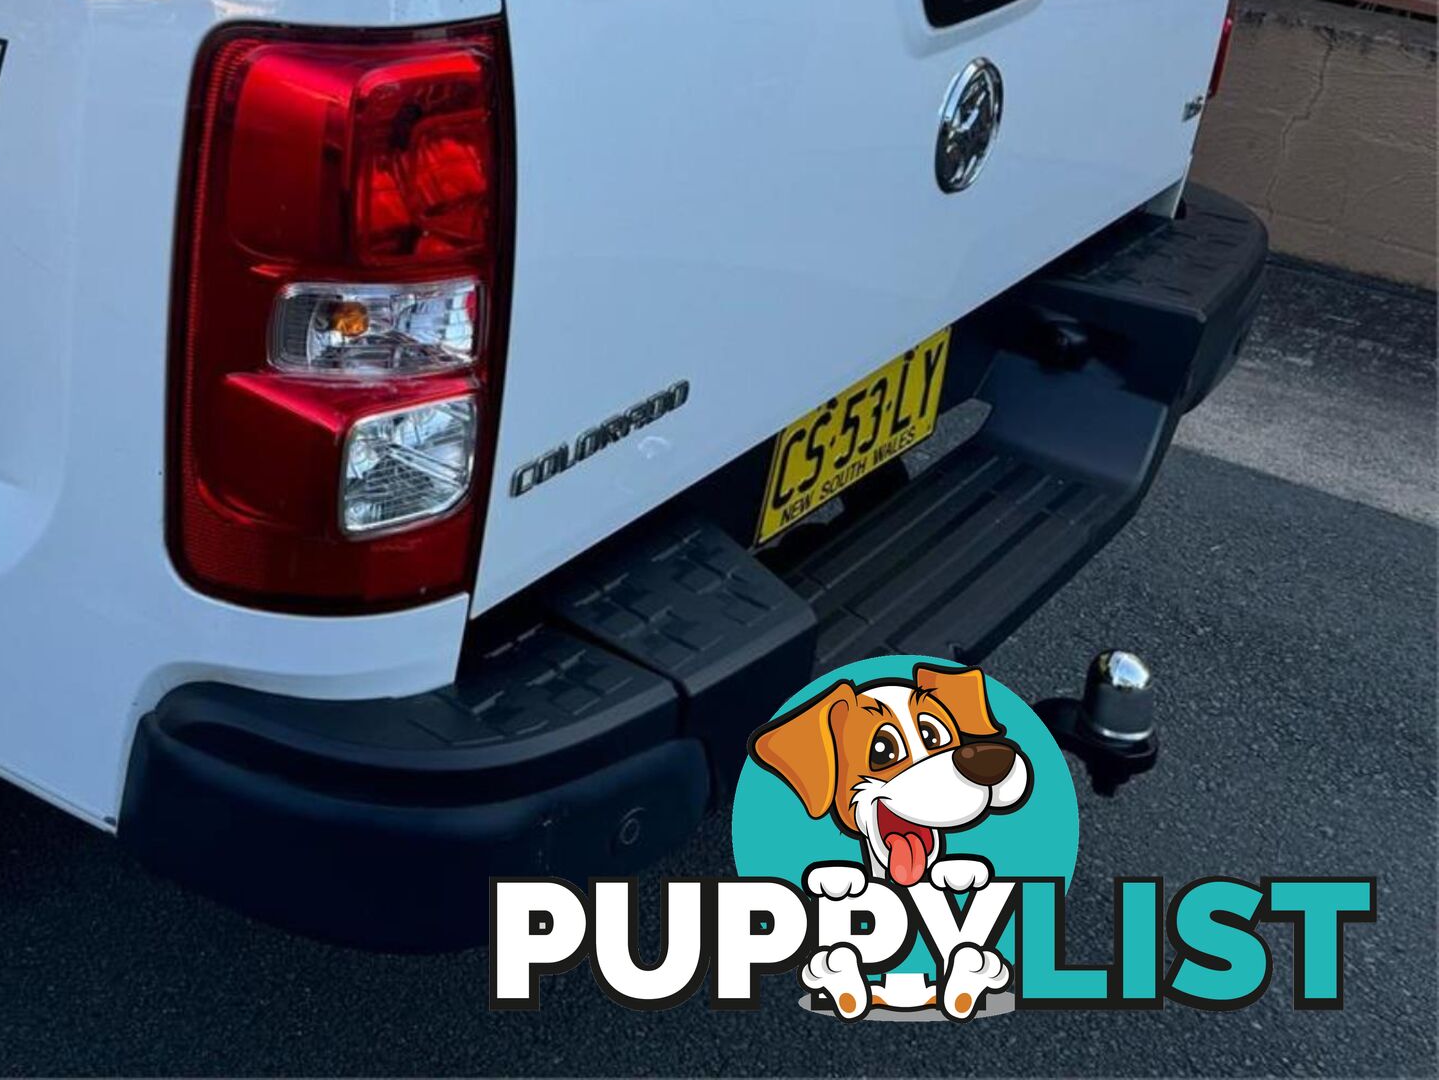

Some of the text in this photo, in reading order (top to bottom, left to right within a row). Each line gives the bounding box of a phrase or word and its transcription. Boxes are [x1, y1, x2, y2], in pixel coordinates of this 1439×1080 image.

[510, 379, 690, 498] COLORADO
[781, 426, 916, 522] NEW SOUTH WALES
